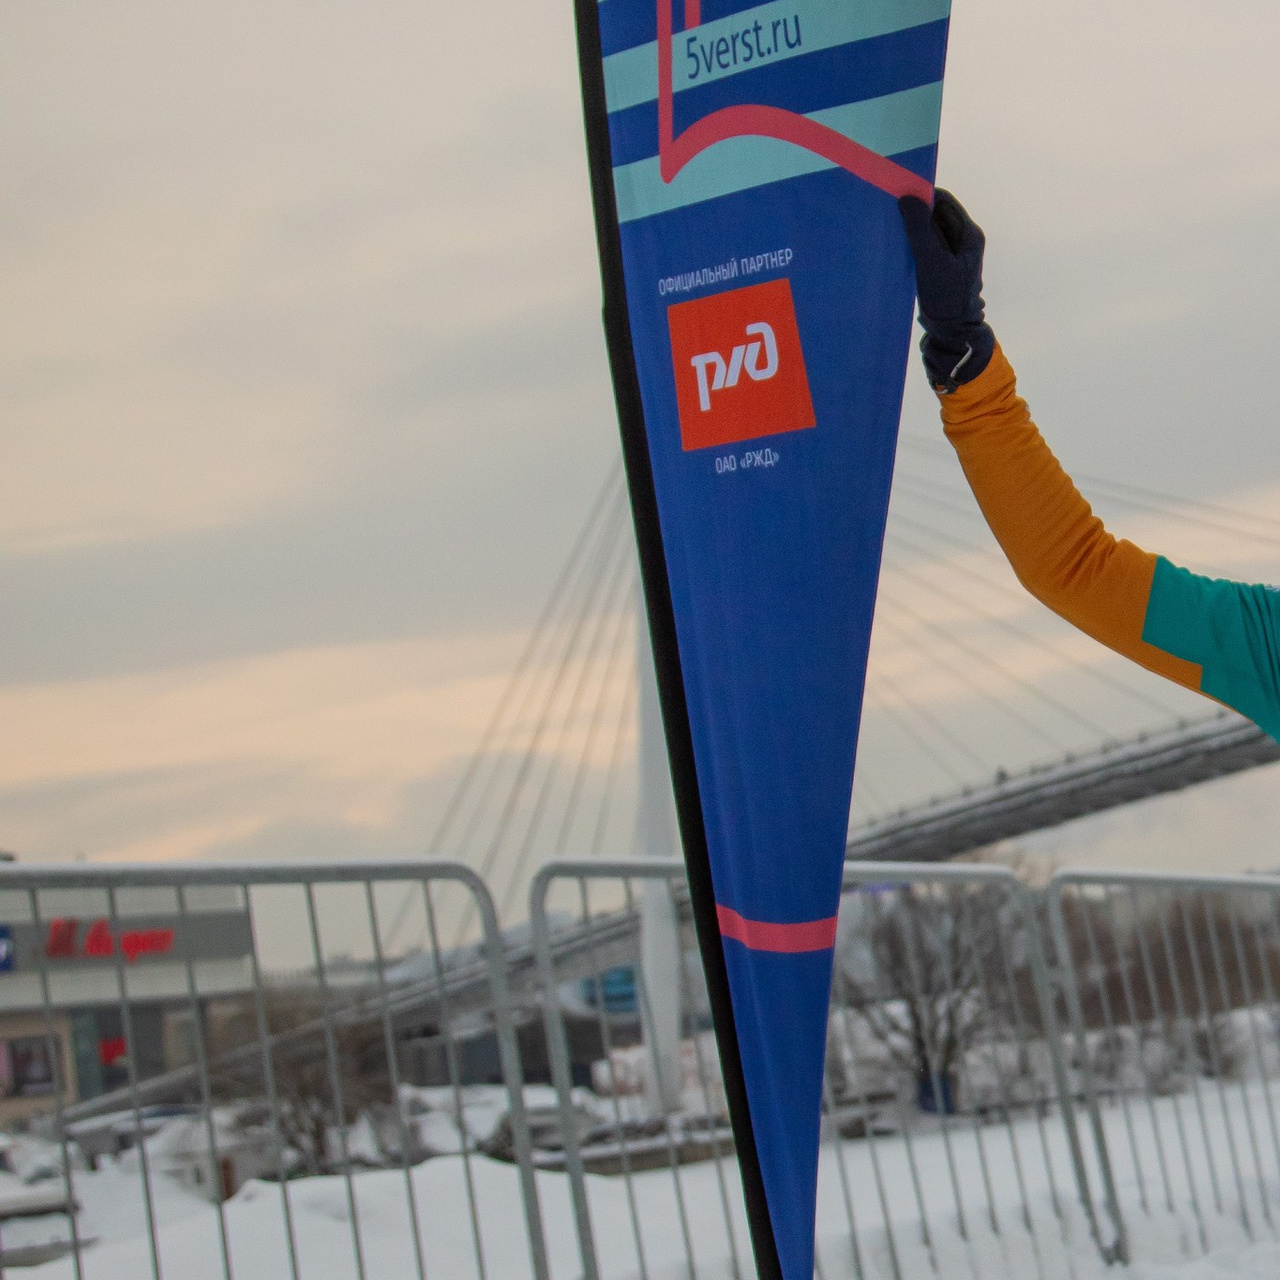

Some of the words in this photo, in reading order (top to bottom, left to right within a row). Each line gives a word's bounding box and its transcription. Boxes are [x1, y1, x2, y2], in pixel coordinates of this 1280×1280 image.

[686, 15, 802, 79] 5verst.ru
[658, 258, 739, 296] ОФИЦИАЛЬНЫЙ
[740, 248, 794, 276] ПАРТНЕР
[715, 454, 736, 474] ОАО
[740, 448, 780, 470] «РЖД»
